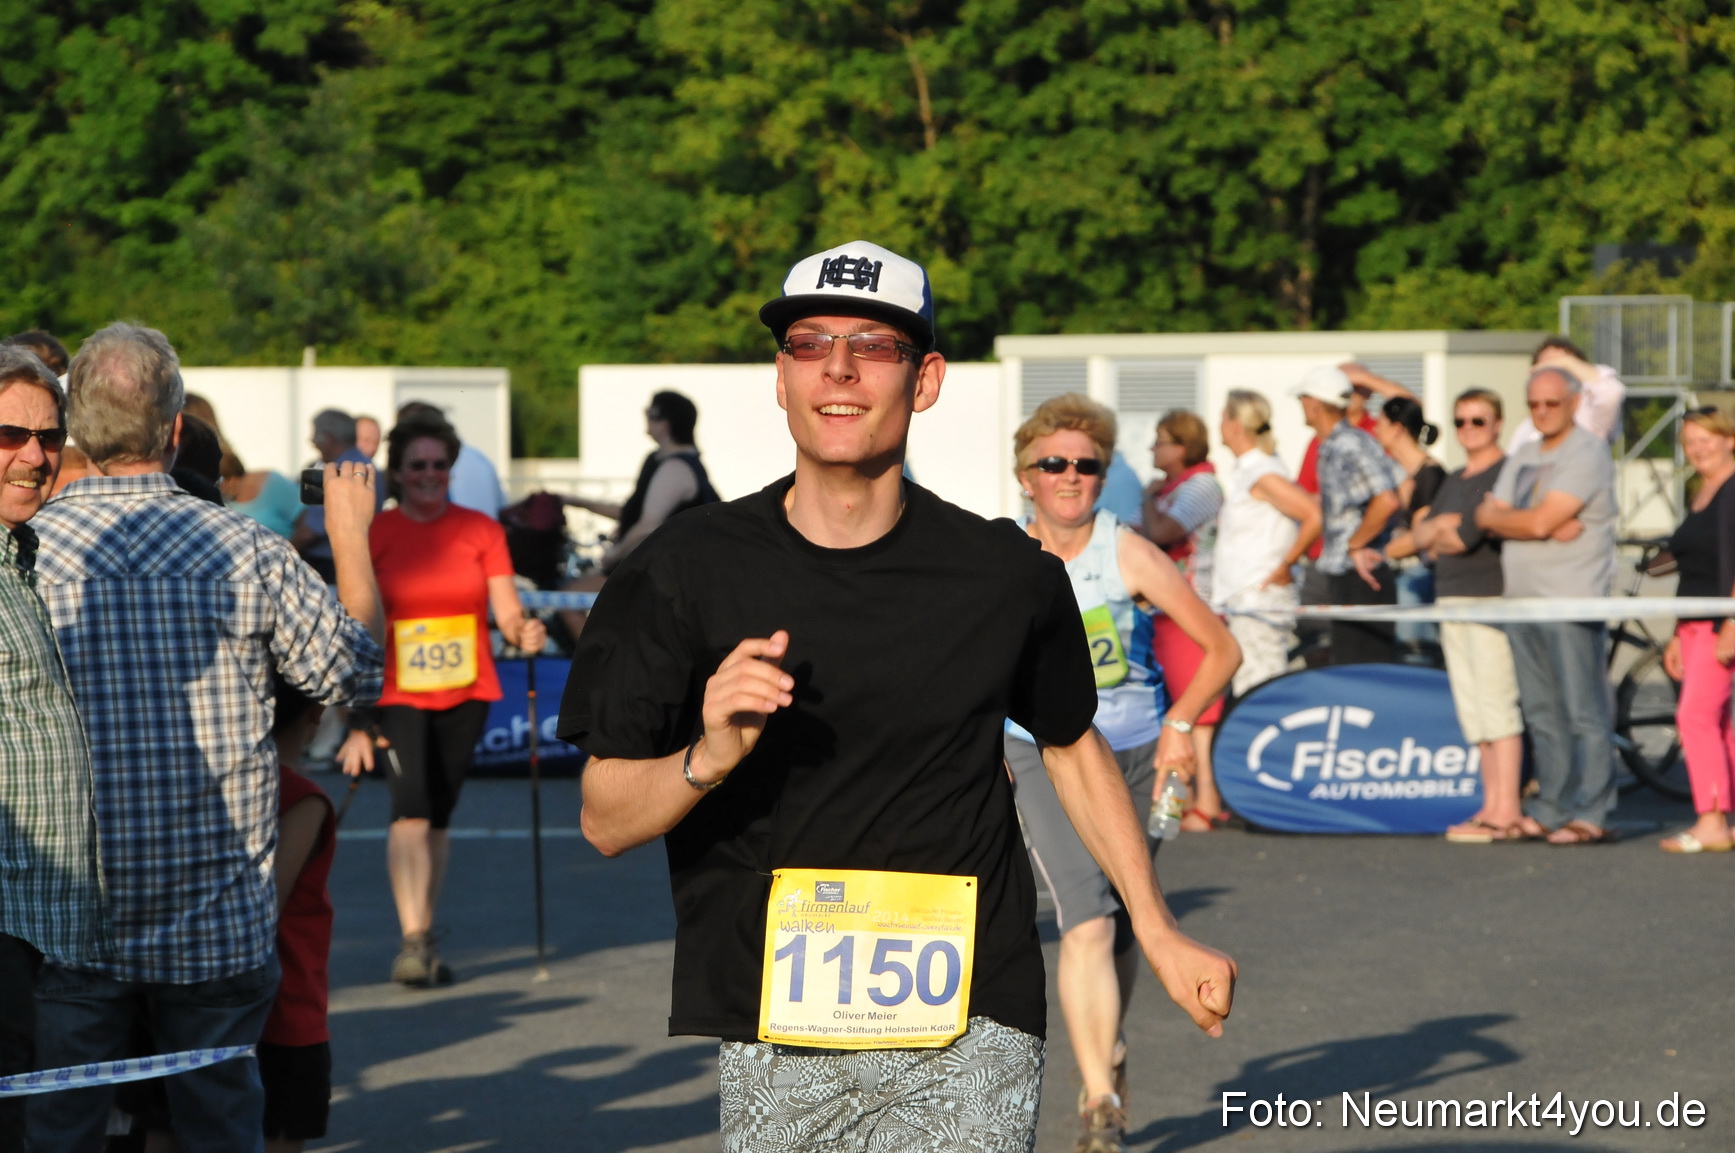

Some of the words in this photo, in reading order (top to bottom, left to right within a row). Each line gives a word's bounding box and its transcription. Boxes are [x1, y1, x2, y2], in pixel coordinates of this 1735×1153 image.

[409, 642, 463, 670] 493
[1308, 778, 1477, 800] AUTOMOBILE
[800, 901, 872, 914] firmenlauf
[871, 910, 910, 923] 2014
[780, 918, 836, 934] walken
[774, 934, 961, 1007] 1150
[833, 1010, 866, 1021] Oliver
[867, 1011, 898, 1021] Meier
[769, 1022, 883, 1036] Regens-Wagner-Stiftung
[884, 1023, 928, 1033] Holnstein
[930, 1023, 956, 1033] KdöR
